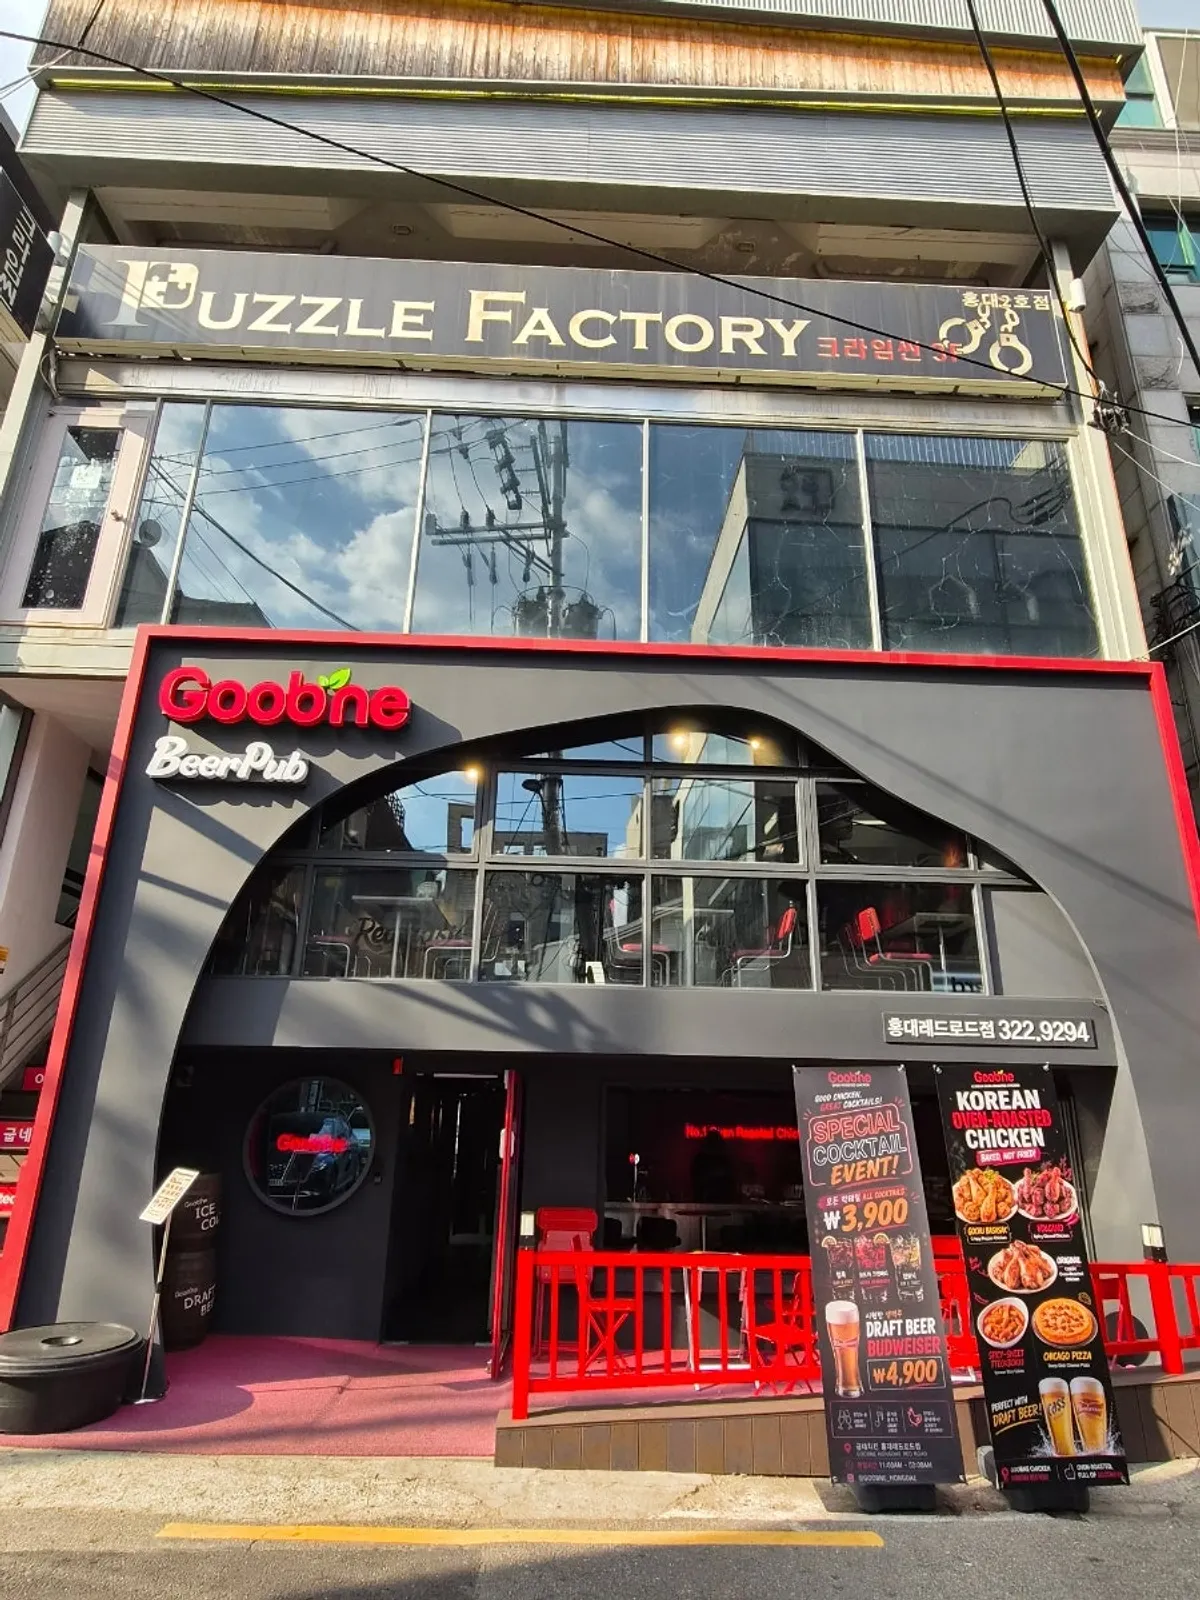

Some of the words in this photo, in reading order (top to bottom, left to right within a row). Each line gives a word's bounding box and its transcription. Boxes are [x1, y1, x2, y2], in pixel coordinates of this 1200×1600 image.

[962, 291, 1050, 310] 홍대2호점
[464, 289, 811, 356] FACTORY
[816, 336, 921, 362] 크라임씬
[887, 1018, 995, 1038] 홍대레드로드점
[998, 1019, 1090, 1042] 322.9294
[956, 1089, 1041, 1111] KOREAN
[813, 1109, 900, 1145] SPECIAL
[952, 1109, 1052, 1129] OVEN-ROASTED
[965, 1127, 1045, 1149] CHICKEN
[813, 1134, 907, 1166] COCKTAIL
[830, 1155, 899, 1186] EVENT!
[195, 1203, 216, 1219] ICE
[866, 1318, 901, 1338] DRAFT
[905, 1317, 936, 1336] BEER
[866, 1336, 941, 1357] BUDWEISER
[1043, 1351, 1070, 1361] CHICAGO
[1071, 1351, 1092, 1360] PIZZA
[991, 1399, 1014, 1413] PERFECT
[992, 1409, 1017, 1428] DRAFT
[1017, 1402, 1042, 1421] BEER!
